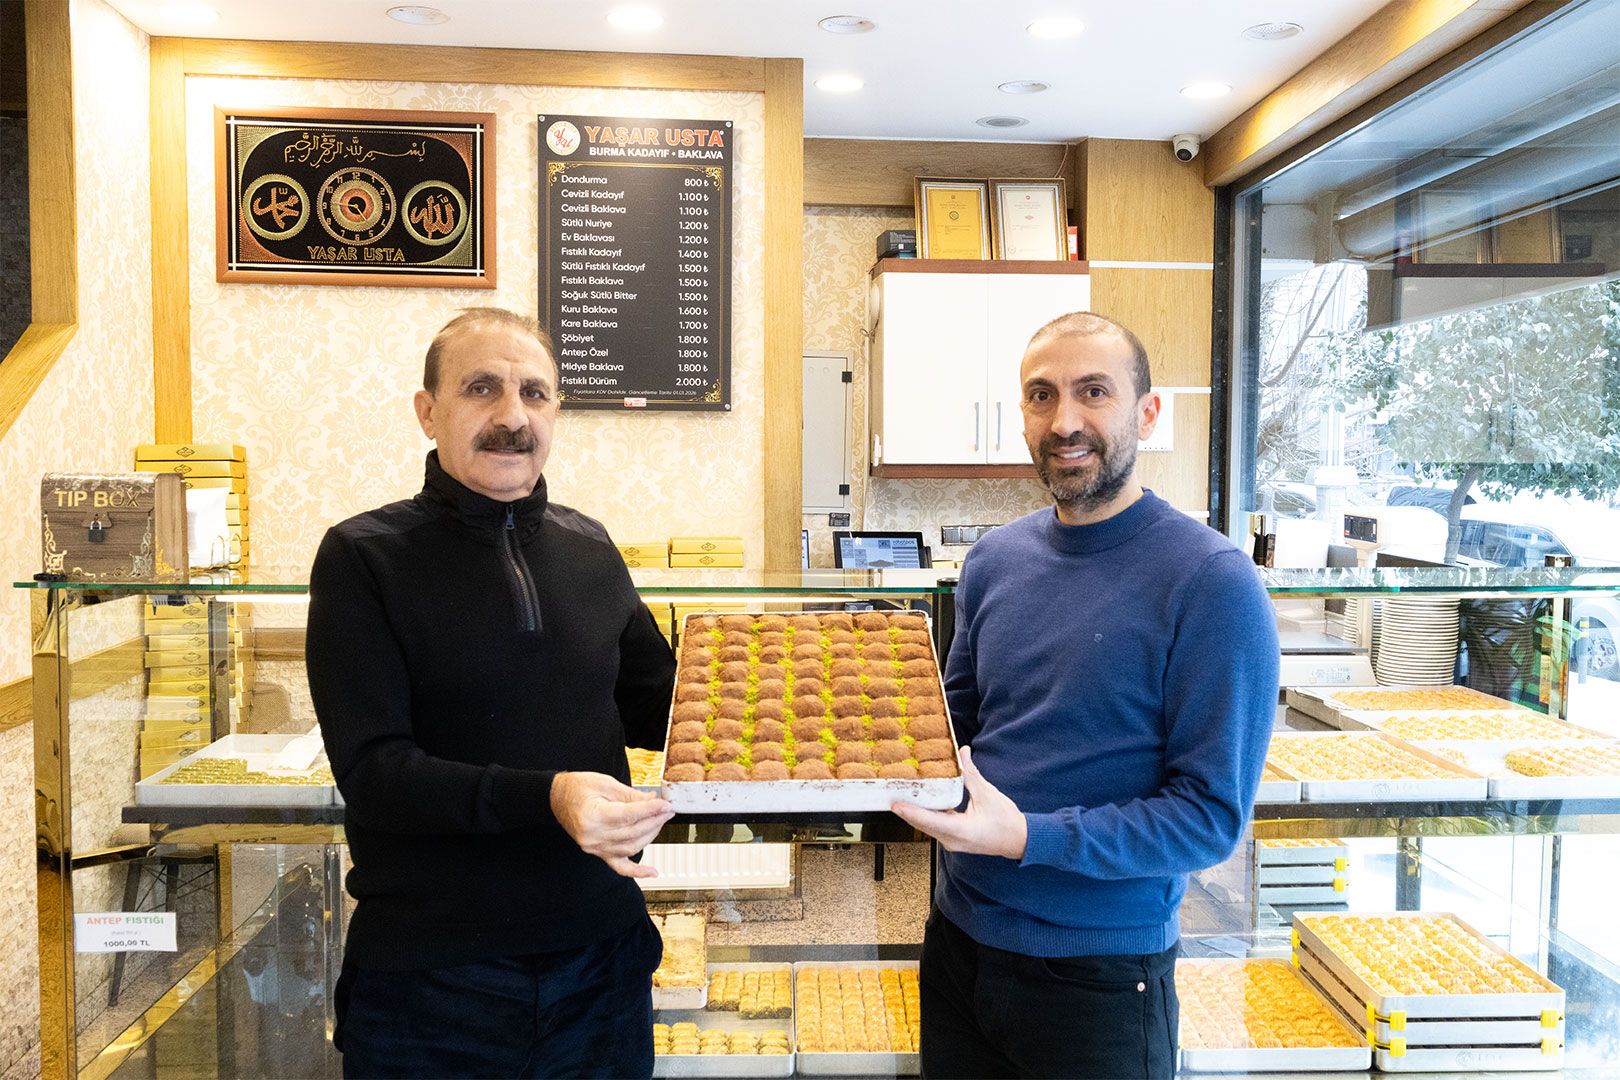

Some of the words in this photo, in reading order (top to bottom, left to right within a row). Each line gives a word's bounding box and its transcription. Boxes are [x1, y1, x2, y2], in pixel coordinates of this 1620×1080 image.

[584, 126, 659, 147] YAŞAR
[666, 129, 724, 146] USTA
[590, 147, 626, 156] BURMA
[627, 147, 669, 157] KADAYIF
[678, 150, 723, 159] BAKLAVA
[562, 175, 607, 184] Dondurma
[685, 178, 702, 186] 800
[561, 189, 589, 198] Cevizli
[591, 190, 624, 200] Kadayıf
[679, 193, 702, 201] 1.100
[561, 204, 589, 212] Cevizli
[591, 205, 626, 213] Baklava
[679, 207, 702, 215] 1.100
[562, 218, 583, 227] Sütlü
[585, 219, 612, 229] Nuriye
[679, 222, 702, 230] 1.200
[574, 233, 614, 242] Baklavası
[679, 236, 702, 244] 1.200
[307, 246, 357, 262] YAŞAR
[364, 247, 406, 262] USTA
[562, 247, 587, 255] Fıstıklı
[589, 248, 622, 258] Kadayıf
[678, 250, 702, 258] 1.400
[562, 262, 583, 270] Sütlü
[613, 263, 645, 272] Kadayıf
[589, 276, 623, 285] Baklava
[679, 279, 701, 287] 1.500
[562, 290, 588, 300] Soğuk
[591, 291, 612, 299] Sütlü
[614, 292, 637, 300] Bitter
[679, 293, 701, 301] 1.500
[583, 305, 617, 313] Baklava
[583, 320, 617, 328] Baklava
[561, 334, 594, 343] Şöbiyet
[561, 348, 587, 358] Antep
[589, 347, 608, 356] Özel
[562, 363, 587, 372] Midye
[589, 363, 623, 371] Baklava
[676, 378, 701, 386] 2.000
[54, 490, 87, 507] TIP
[94, 490, 140, 507] BOX
[126, 916, 164, 924] FISTIĞI
